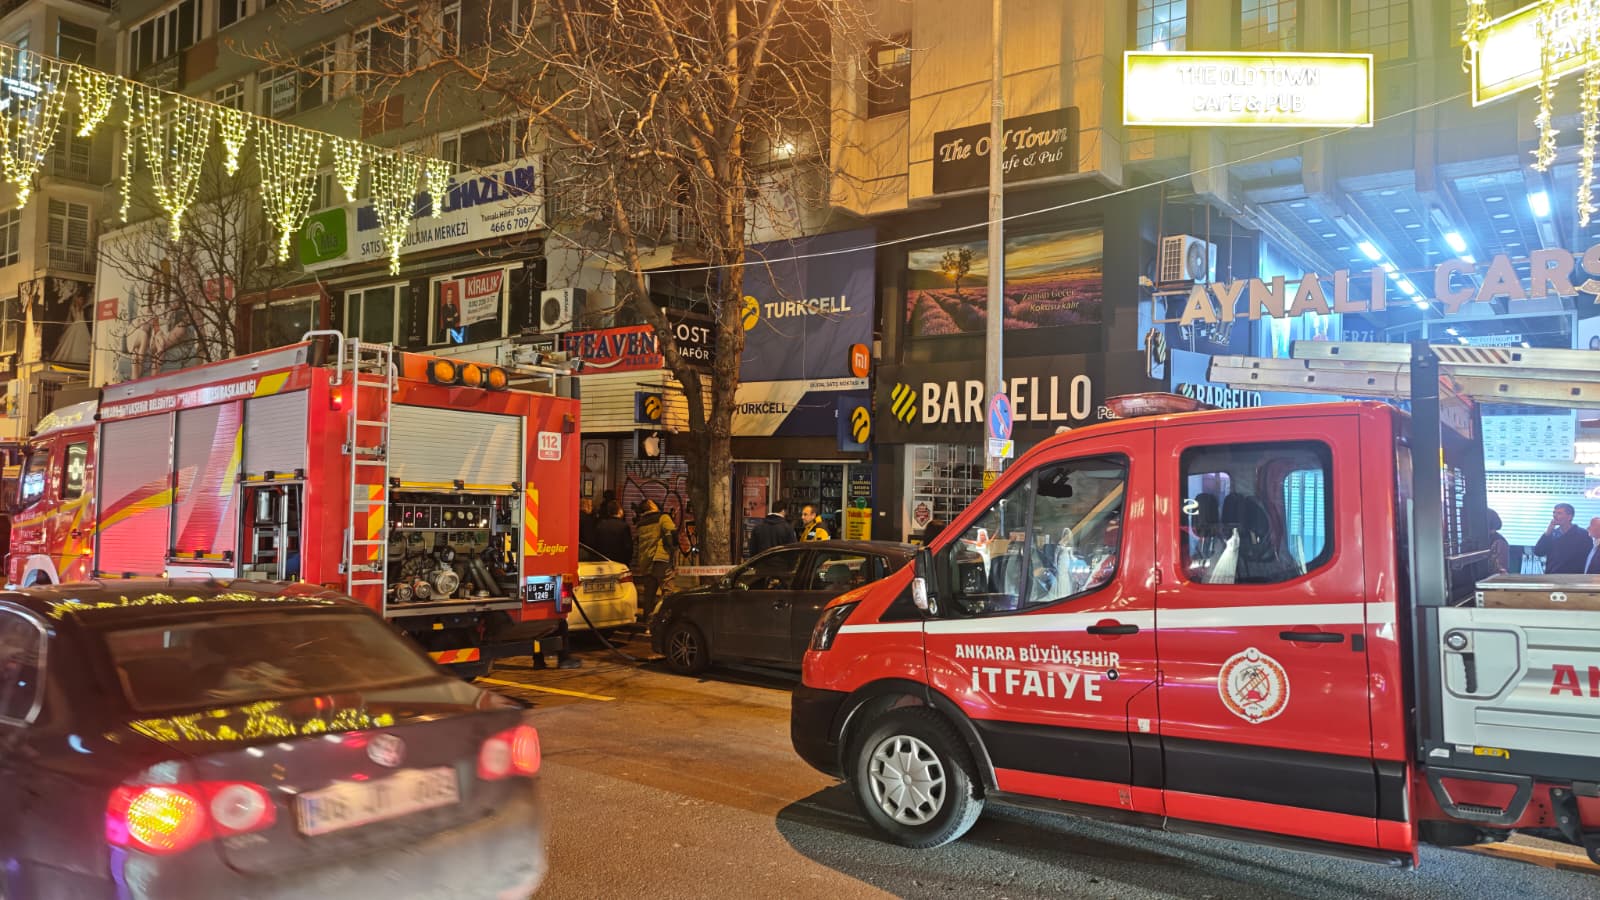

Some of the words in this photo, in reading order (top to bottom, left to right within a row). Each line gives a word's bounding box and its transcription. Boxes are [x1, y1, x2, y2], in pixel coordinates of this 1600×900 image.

[1178, 66, 1217, 84] THE
[1220, 67, 1257, 86] OLD
[1260, 67, 1321, 86] TOWN
[1245, 95, 1262, 112] &
[1265, 95, 1306, 112] PUB
[940, 138, 971, 162] The
[975, 130, 1010, 156] Od
[1013, 126, 1068, 150] Town
[1001, 154, 1019, 174] afe
[1022, 151, 1037, 167] &
[1038, 147, 1064, 165] Pub
[434, 216, 469, 241] MERKEZİ
[490, 222, 506, 233] 466
[514, 216, 530, 230] 709
[468, 275, 500, 297] KİRALIK
[1180, 267, 1387, 326] AYNALI
[764, 295, 852, 319] TURKCELL
[565, 331, 659, 360] HEAVEN
[678, 346, 710, 360] AFÖR
[736, 402, 788, 415] TURKCELL
[921, 374, 1092, 425] BARELLO
[541, 435, 558, 449] 112
[955, 644, 1014, 662] ANKARA
[1019, 643, 1121, 668] BÜYÜKŞEHİR
[972, 666, 1103, 702] İTFAİYE
